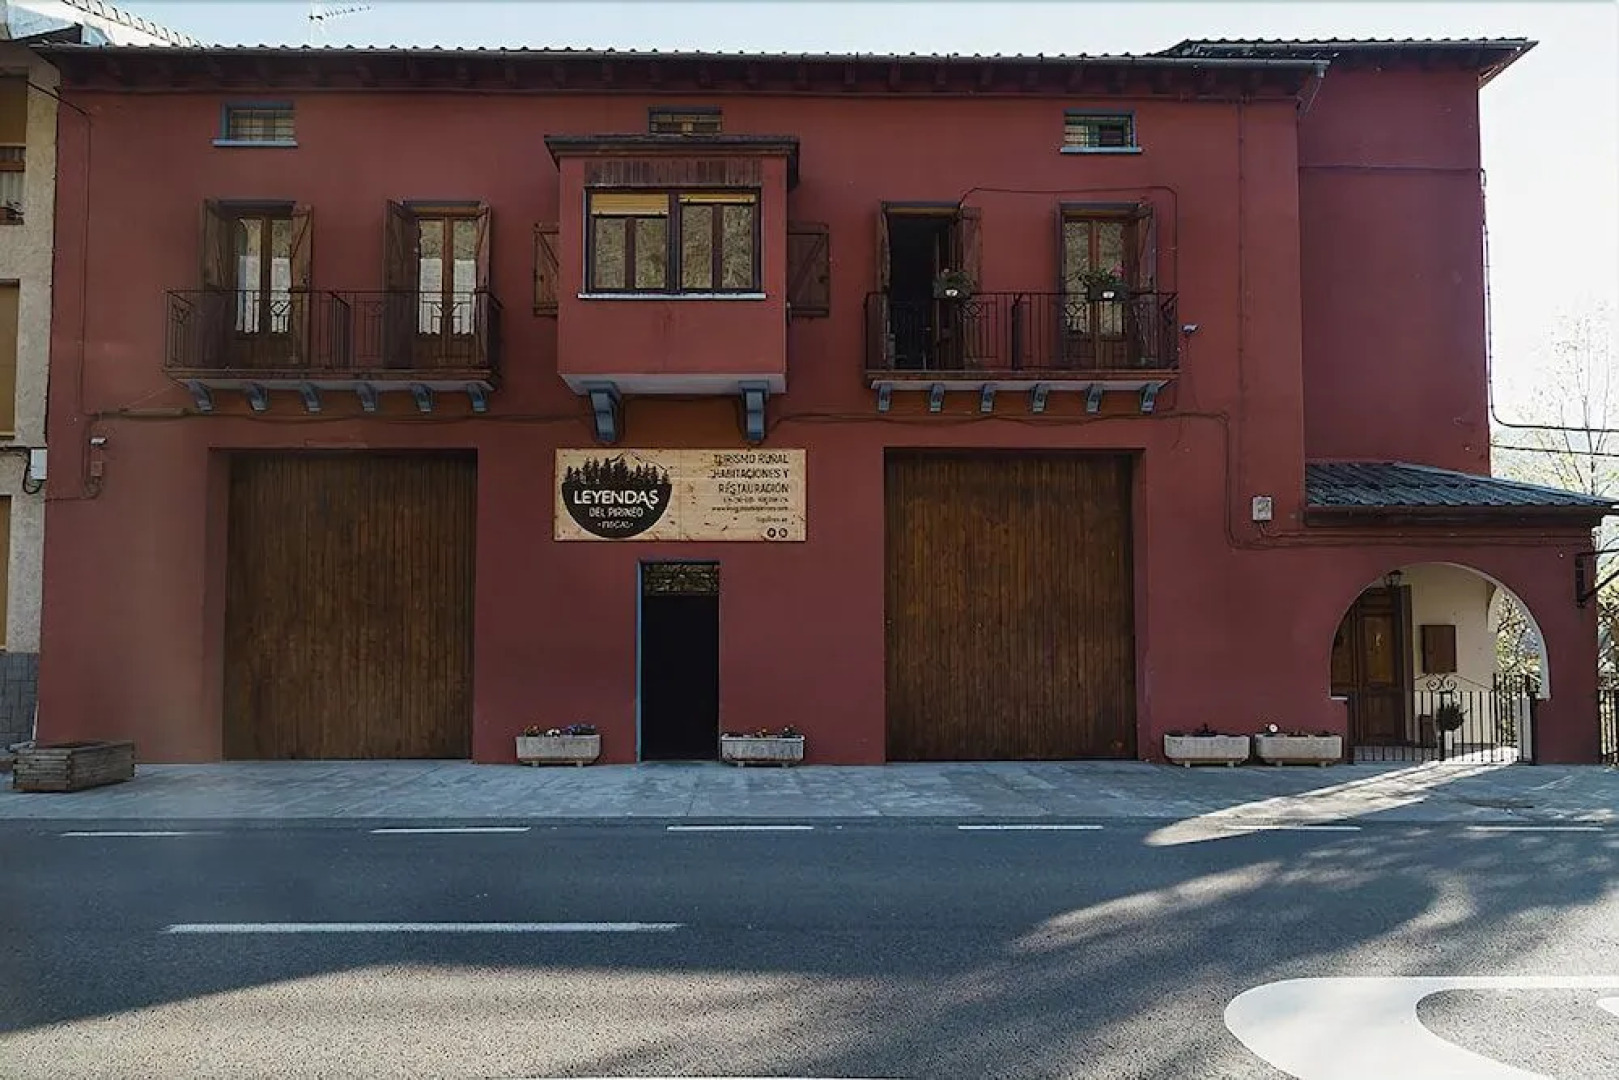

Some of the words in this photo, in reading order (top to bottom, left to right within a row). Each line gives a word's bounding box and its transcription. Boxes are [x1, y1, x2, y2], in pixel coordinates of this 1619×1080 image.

[713, 454, 755, 465] TURISMO
[758, 454, 789, 464] RURAL
[713, 469, 781, 479] HABITACIONES
[783, 469, 789, 478] Y
[574, 490, 660, 510] LEYENDAS
[589, 507, 605, 517] DEL
[608, 507, 643, 517] PIRINEO
